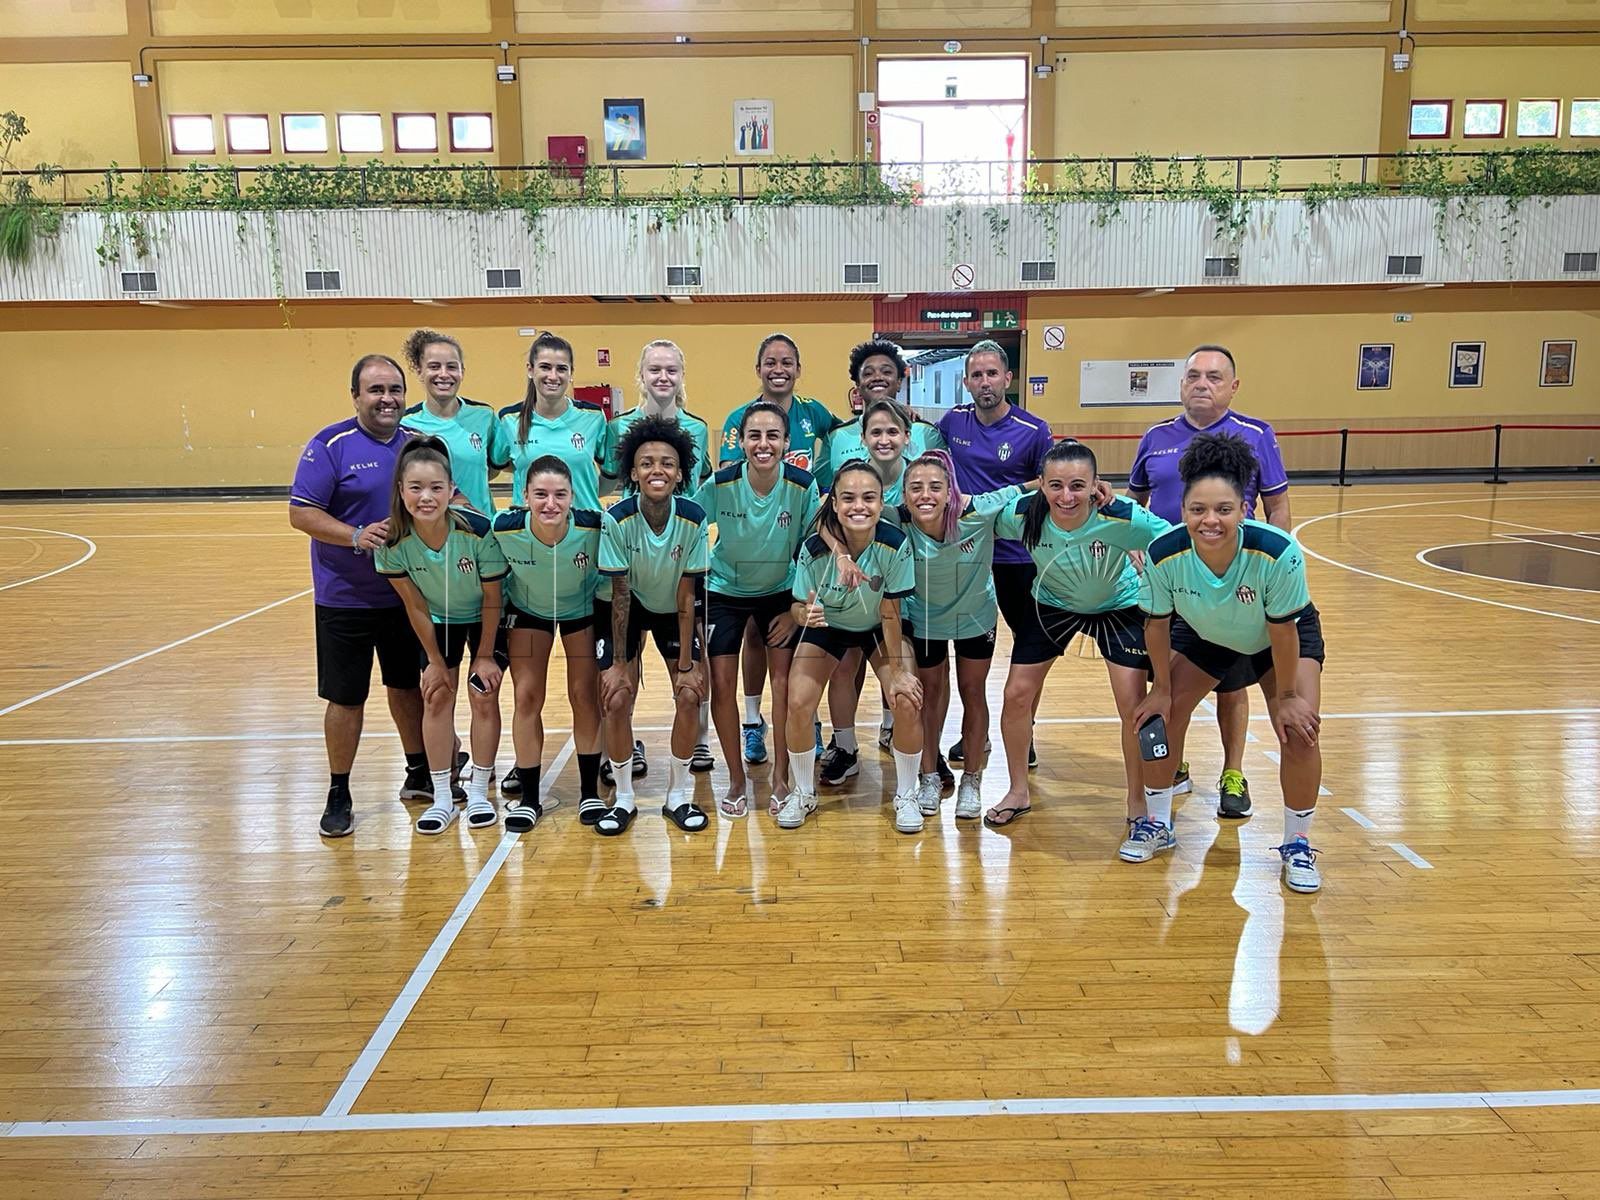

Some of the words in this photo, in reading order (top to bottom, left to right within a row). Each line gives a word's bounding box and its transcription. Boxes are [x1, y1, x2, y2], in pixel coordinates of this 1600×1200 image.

[727, 427, 738, 450] vivo
[952, 436, 972, 447] KELME
[349, 460, 380, 472] KELME
[720, 510, 748, 520] KELME
[1123, 646, 1148, 657] KELM
